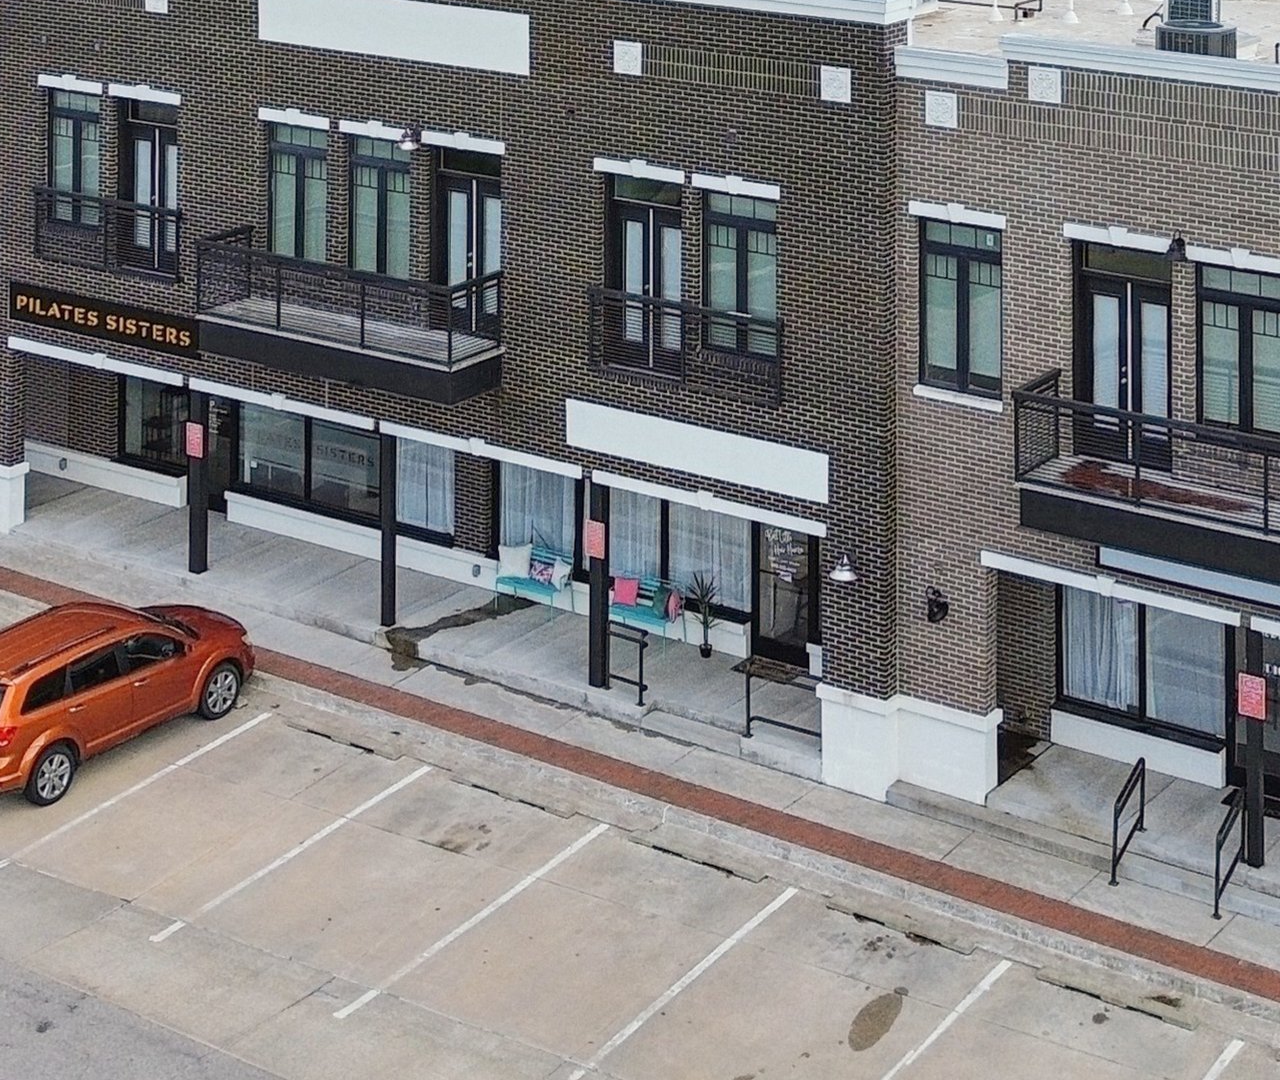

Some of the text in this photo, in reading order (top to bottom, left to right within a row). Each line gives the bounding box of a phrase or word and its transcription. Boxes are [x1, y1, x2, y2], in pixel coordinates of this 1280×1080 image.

[16, 294, 191, 347] PILATES SISTERS
[317, 445, 375, 467] SISTERS
